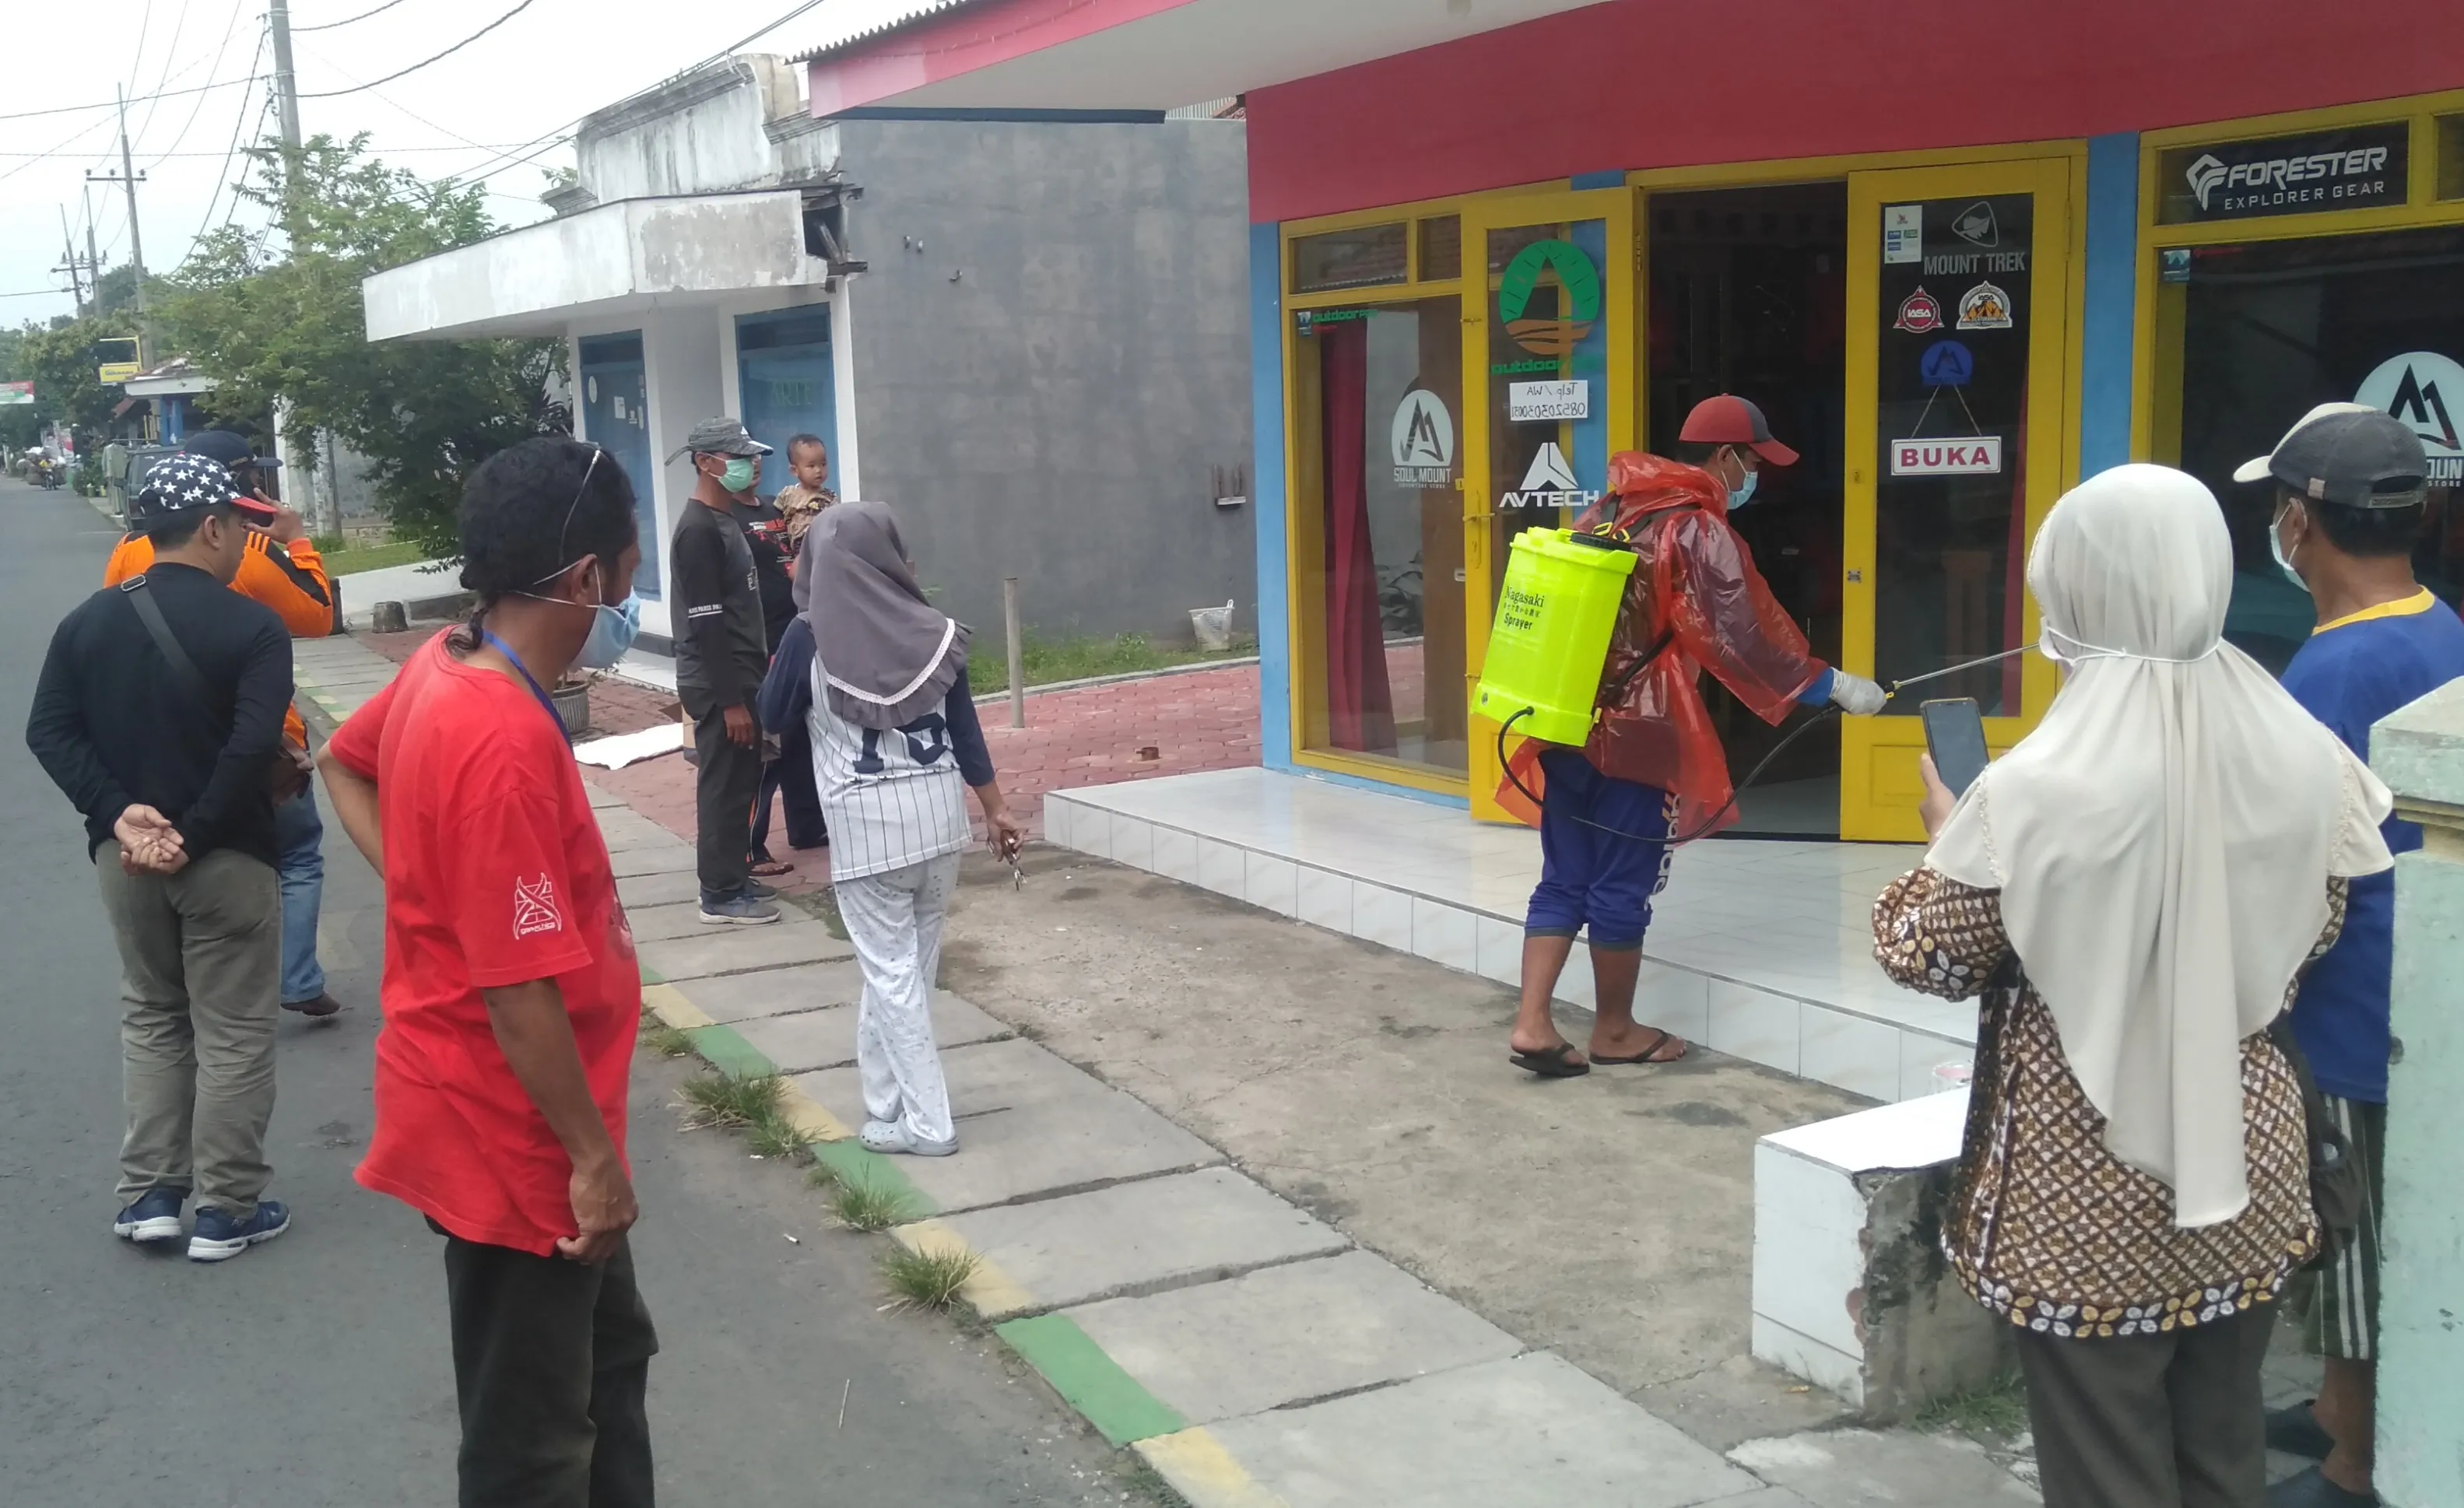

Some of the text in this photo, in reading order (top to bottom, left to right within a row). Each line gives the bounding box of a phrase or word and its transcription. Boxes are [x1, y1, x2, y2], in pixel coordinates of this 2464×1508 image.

[2227, 146, 2389, 191] FORESTER
[2225, 181, 2385, 211] EXPLORER GEAR
[1924, 251, 2025, 275] MOUNT TREK
[1901, 446, 1991, 468] BUKA
[1394, 467, 1451, 483] SOUL MOUNT
[1499, 489, 1600, 508] AVTECH
[1504, 585, 1545, 608] Nagasaki
[1504, 612, 1533, 630] Sprayer
